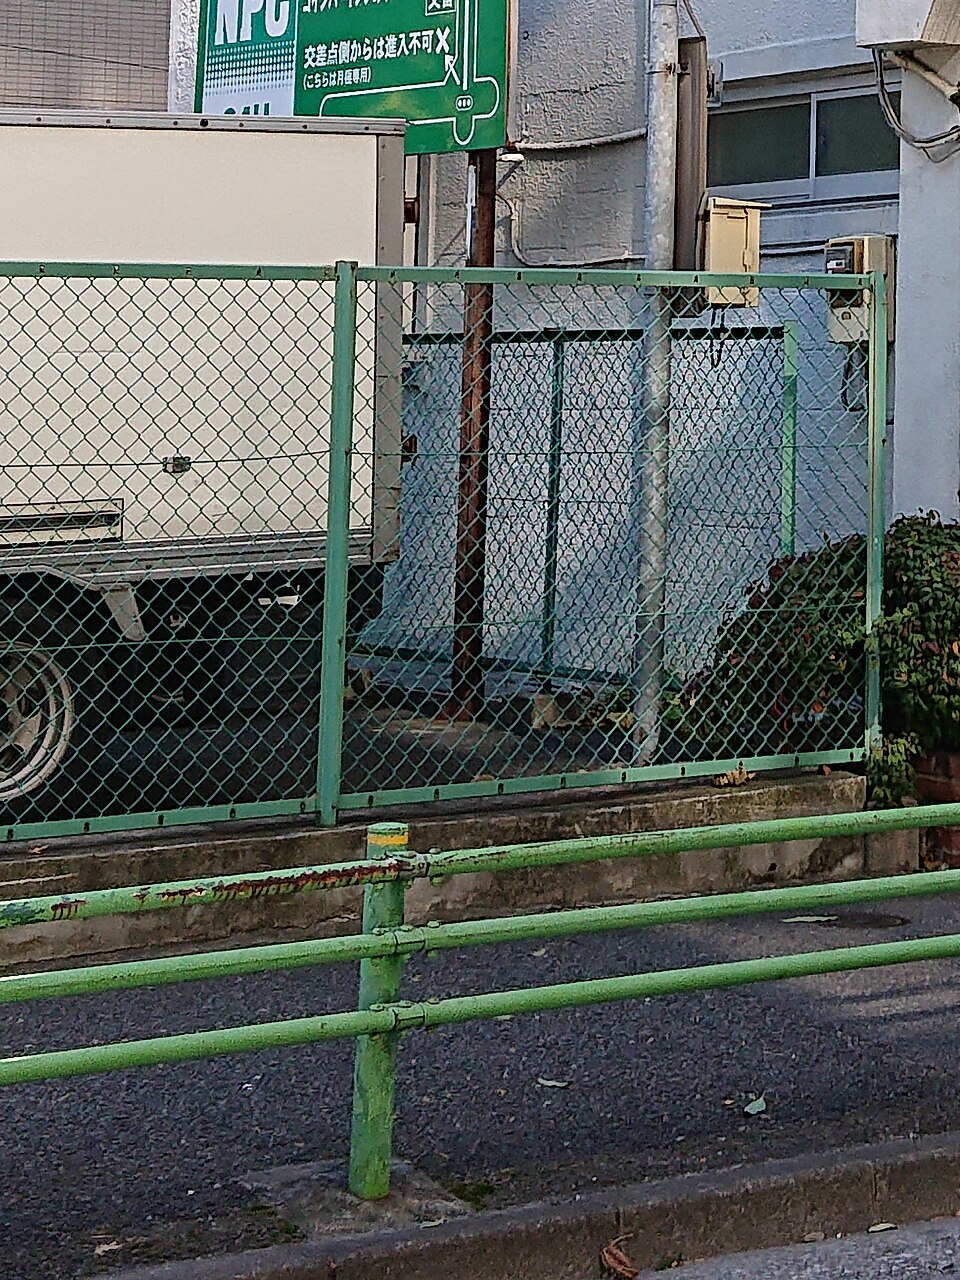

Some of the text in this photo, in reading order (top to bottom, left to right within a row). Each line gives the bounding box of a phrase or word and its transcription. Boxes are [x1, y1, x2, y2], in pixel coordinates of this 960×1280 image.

[303, 29, 435, 69] 交差点側からは進入不可
